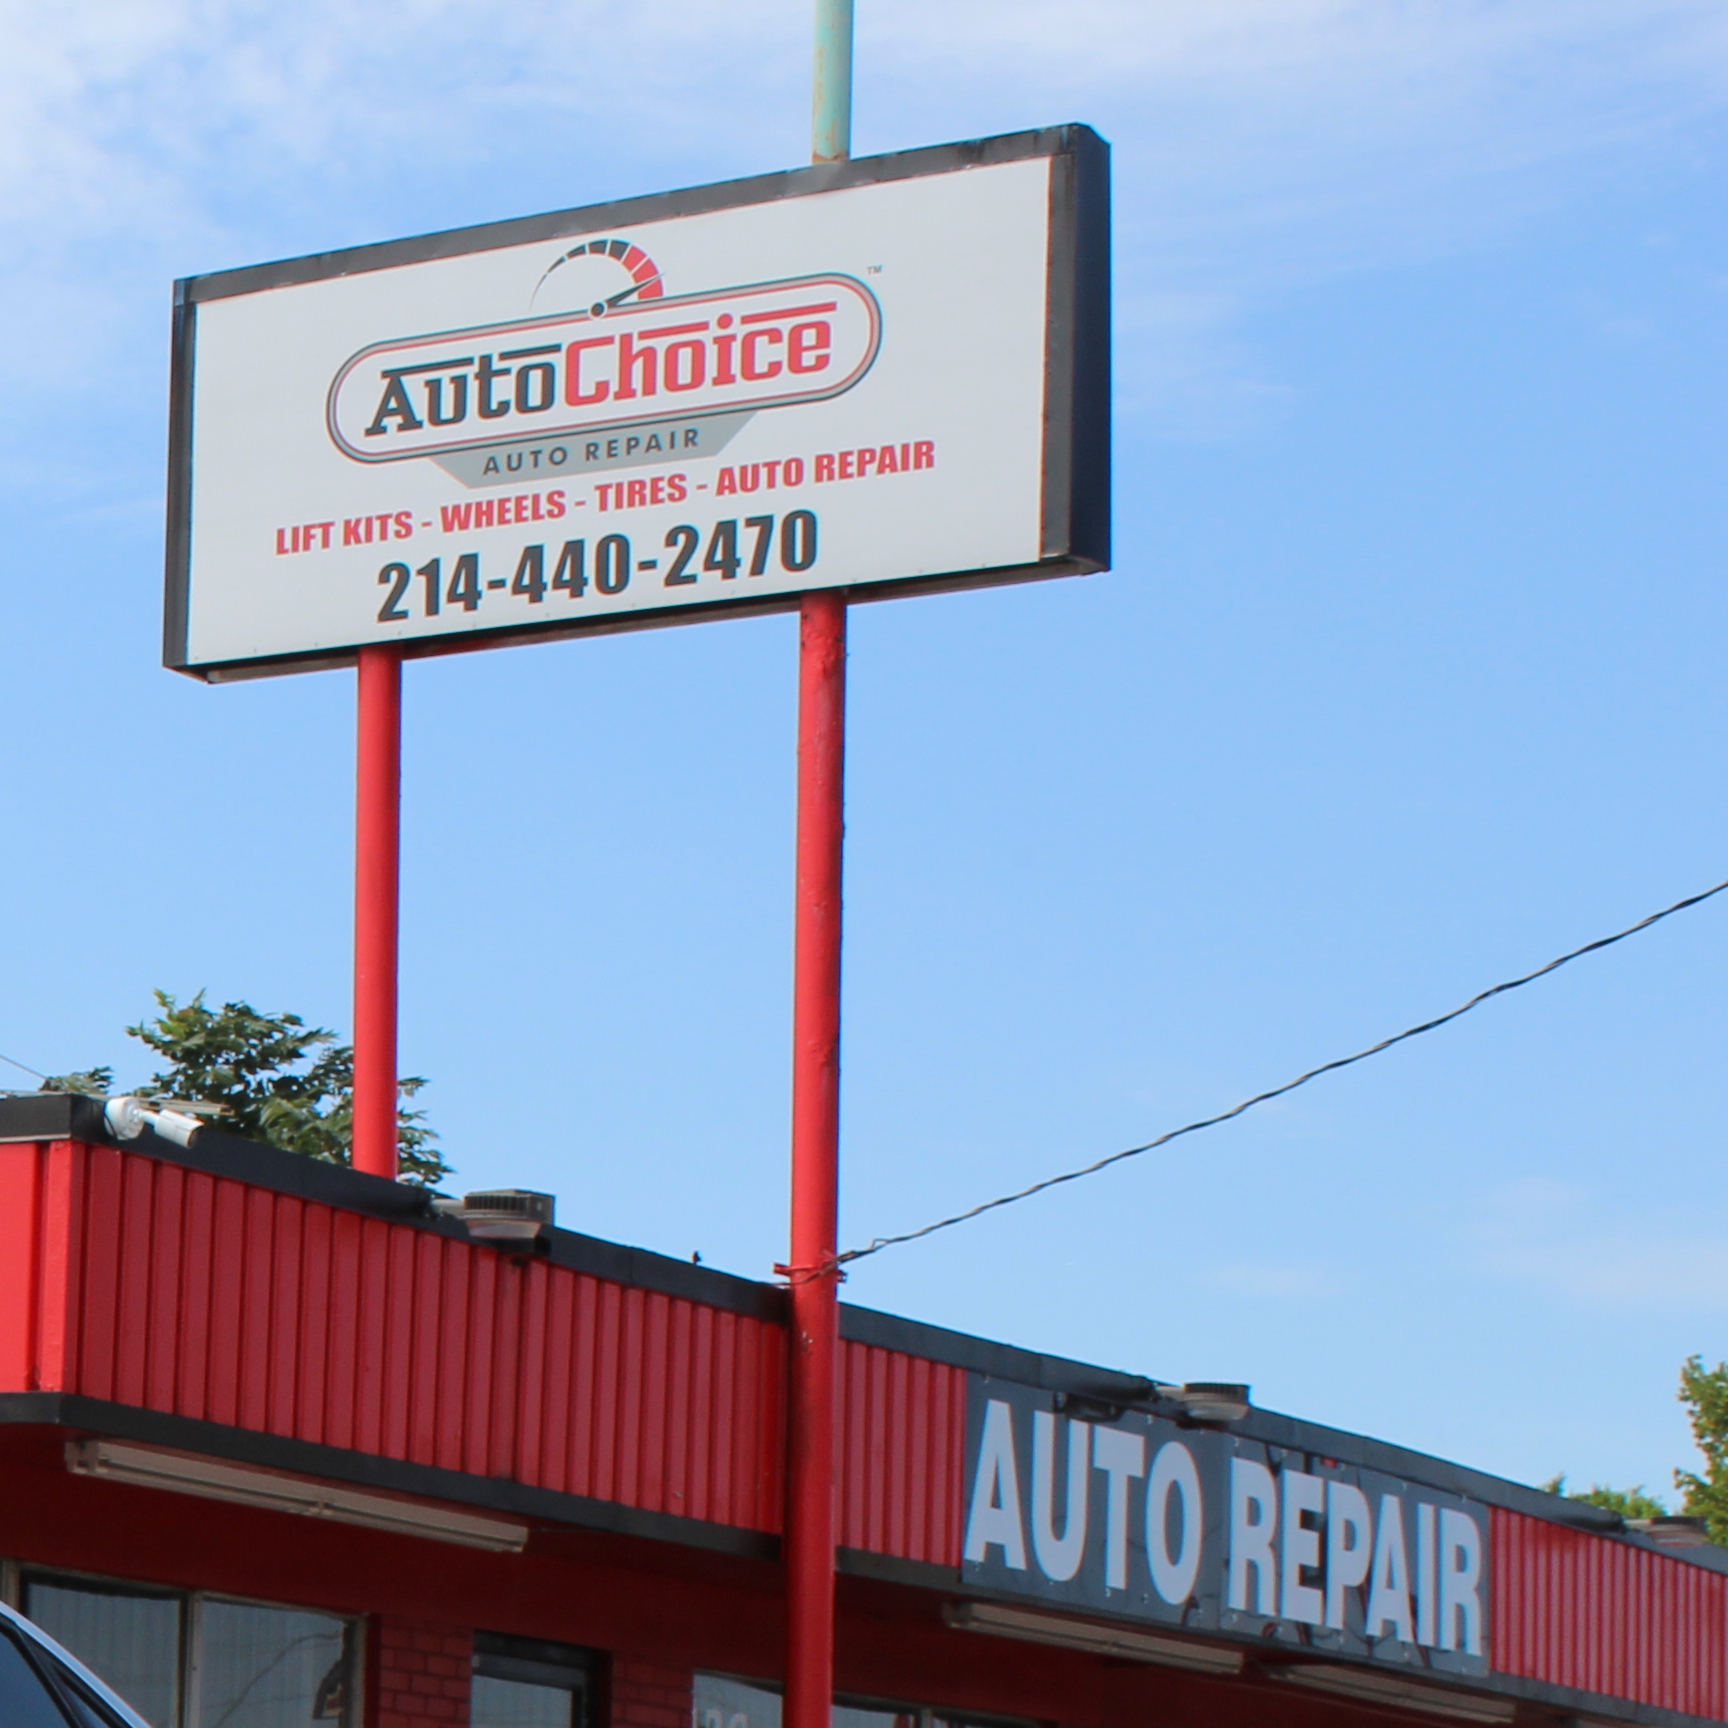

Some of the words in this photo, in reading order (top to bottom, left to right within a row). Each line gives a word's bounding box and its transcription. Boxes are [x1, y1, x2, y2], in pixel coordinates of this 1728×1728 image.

[364, 301, 837, 437] AutoChoice
[275, 521, 335, 555] LIFT
[342, 511, 413, 546] KITS
[440, 490, 567, 533] WHEELS
[594, 473, 687, 512] TIRES
[715, 457, 803, 496] AUTO
[814, 440, 935, 484] REPAIR
[482, 446, 569, 476] AUTO
[584, 428, 700, 462] REPAIR
[377, 508, 818, 624] 214-440-2470
[962, 1398, 1204, 1606] AUTO
[1227, 1455, 1484, 1658] REPAIR
